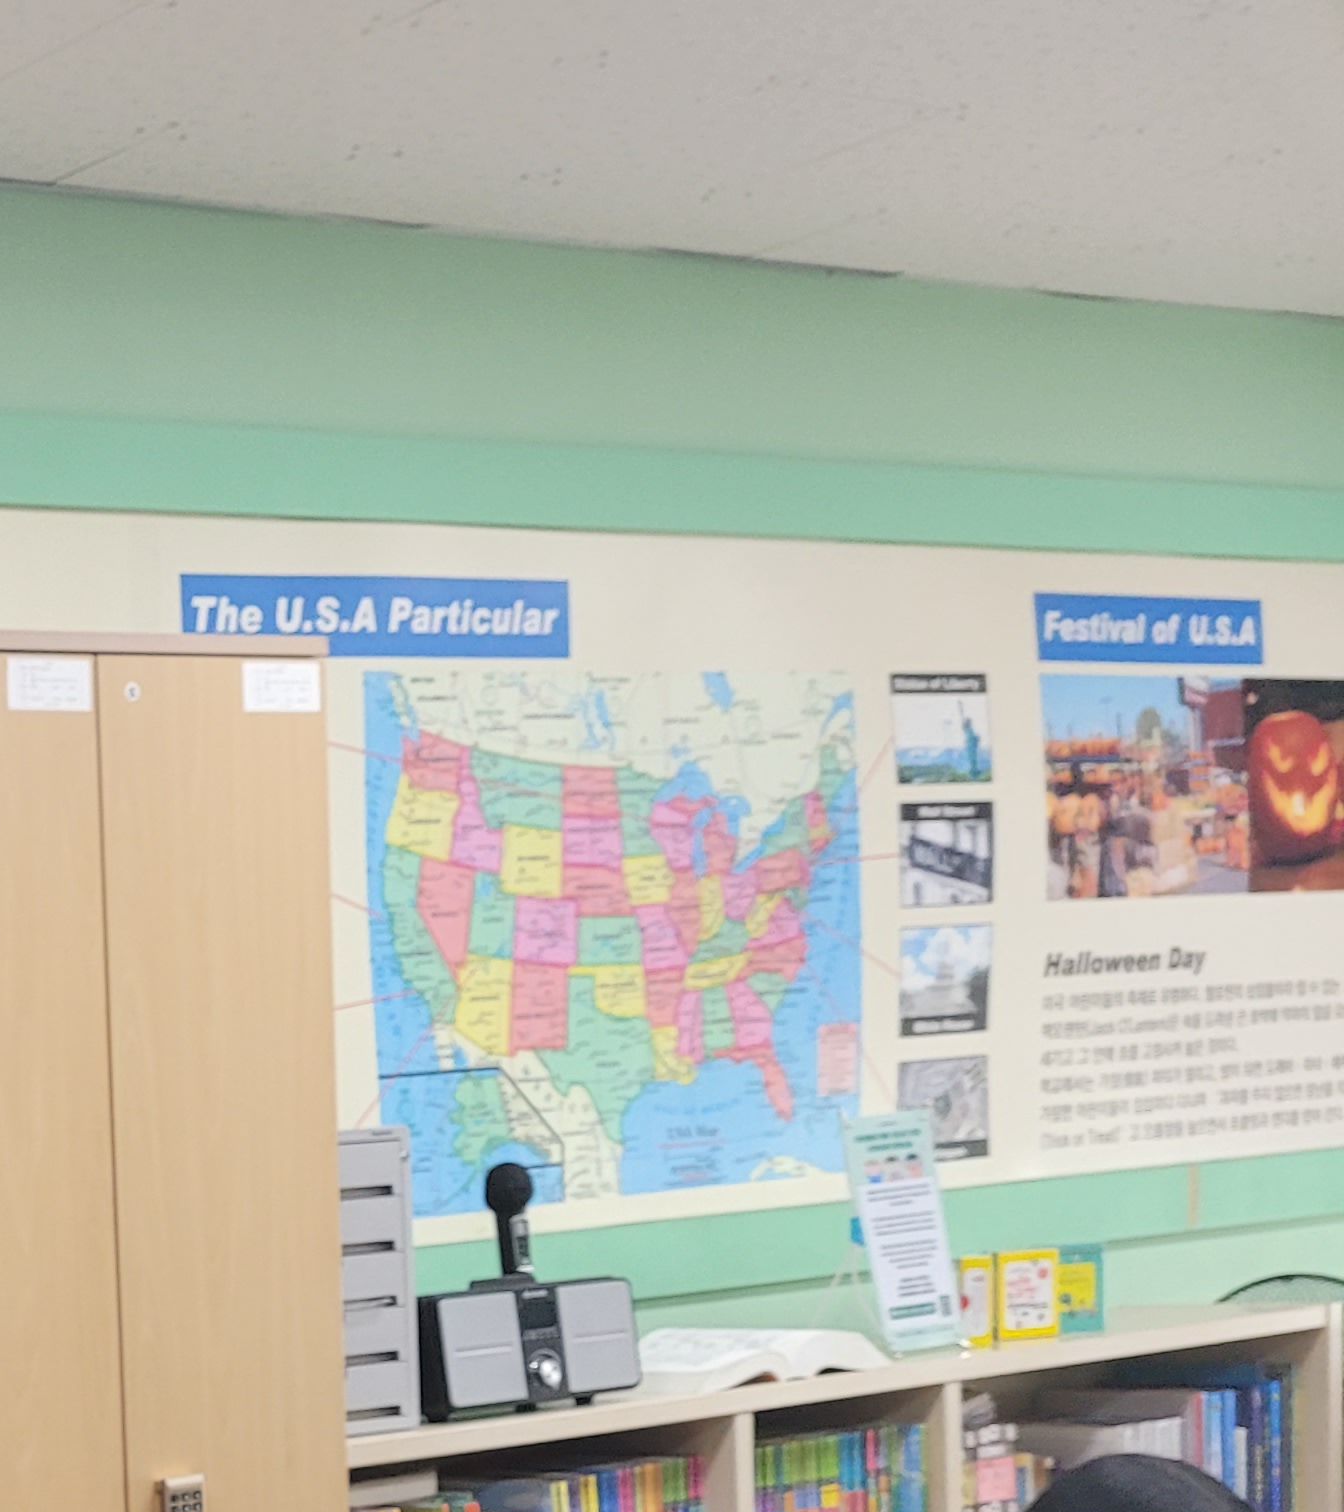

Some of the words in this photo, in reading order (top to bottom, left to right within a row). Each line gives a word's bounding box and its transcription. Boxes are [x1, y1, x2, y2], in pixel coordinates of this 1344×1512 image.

[190, 595, 263, 633] The
[276, 596, 378, 634] U.S.A
[387, 597, 560, 635] Particular
[1043, 610, 1146, 643] Festival
[1152, 613, 1180, 645] of
[1189, 614, 1256, 645] U.S.A
[1043, 950, 1161, 978] Halloween
[1167, 947, 1206, 975] Day
